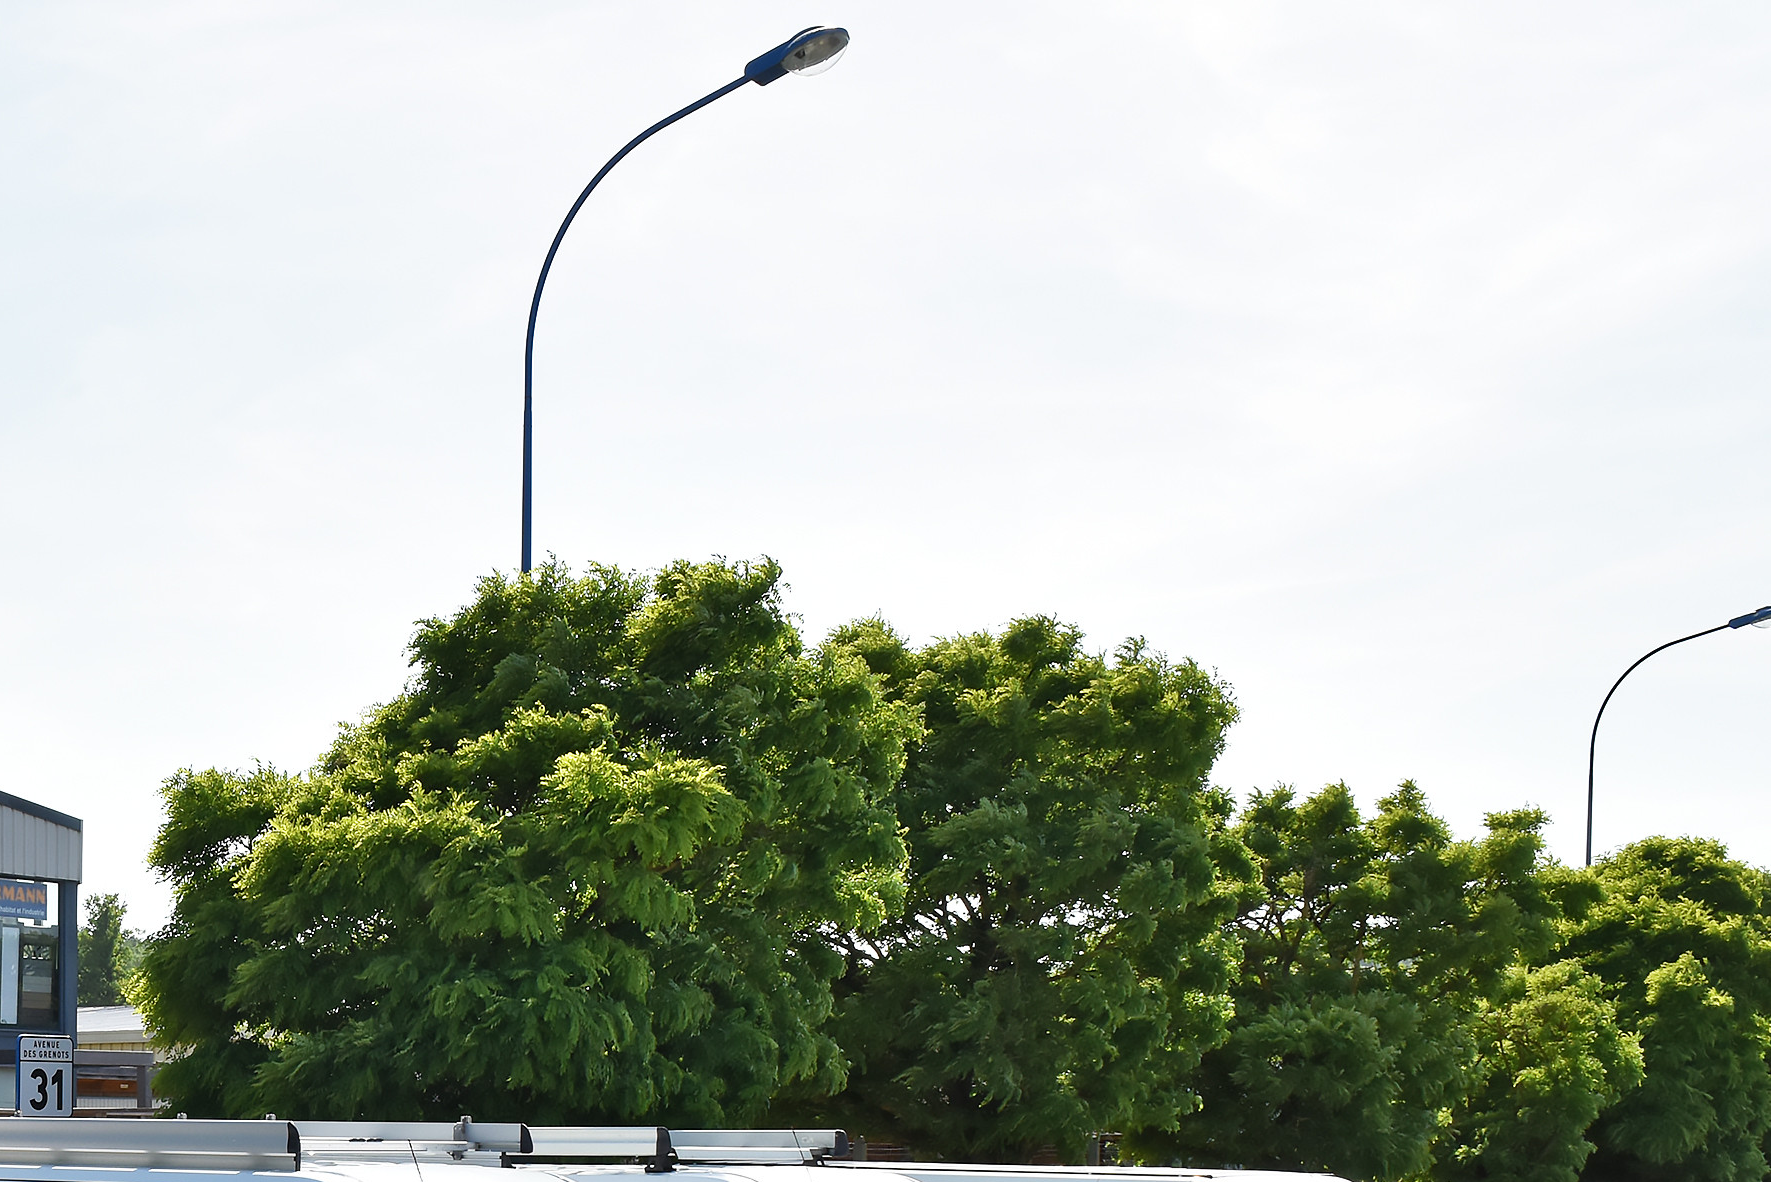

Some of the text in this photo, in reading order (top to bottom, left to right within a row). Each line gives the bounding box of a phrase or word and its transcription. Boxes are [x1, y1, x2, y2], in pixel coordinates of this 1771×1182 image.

[33, 1040, 60, 1049] AVENUE
[23, 1050, 69, 1059] DES GRENOTS
[29, 1068, 63, 1111] 31
